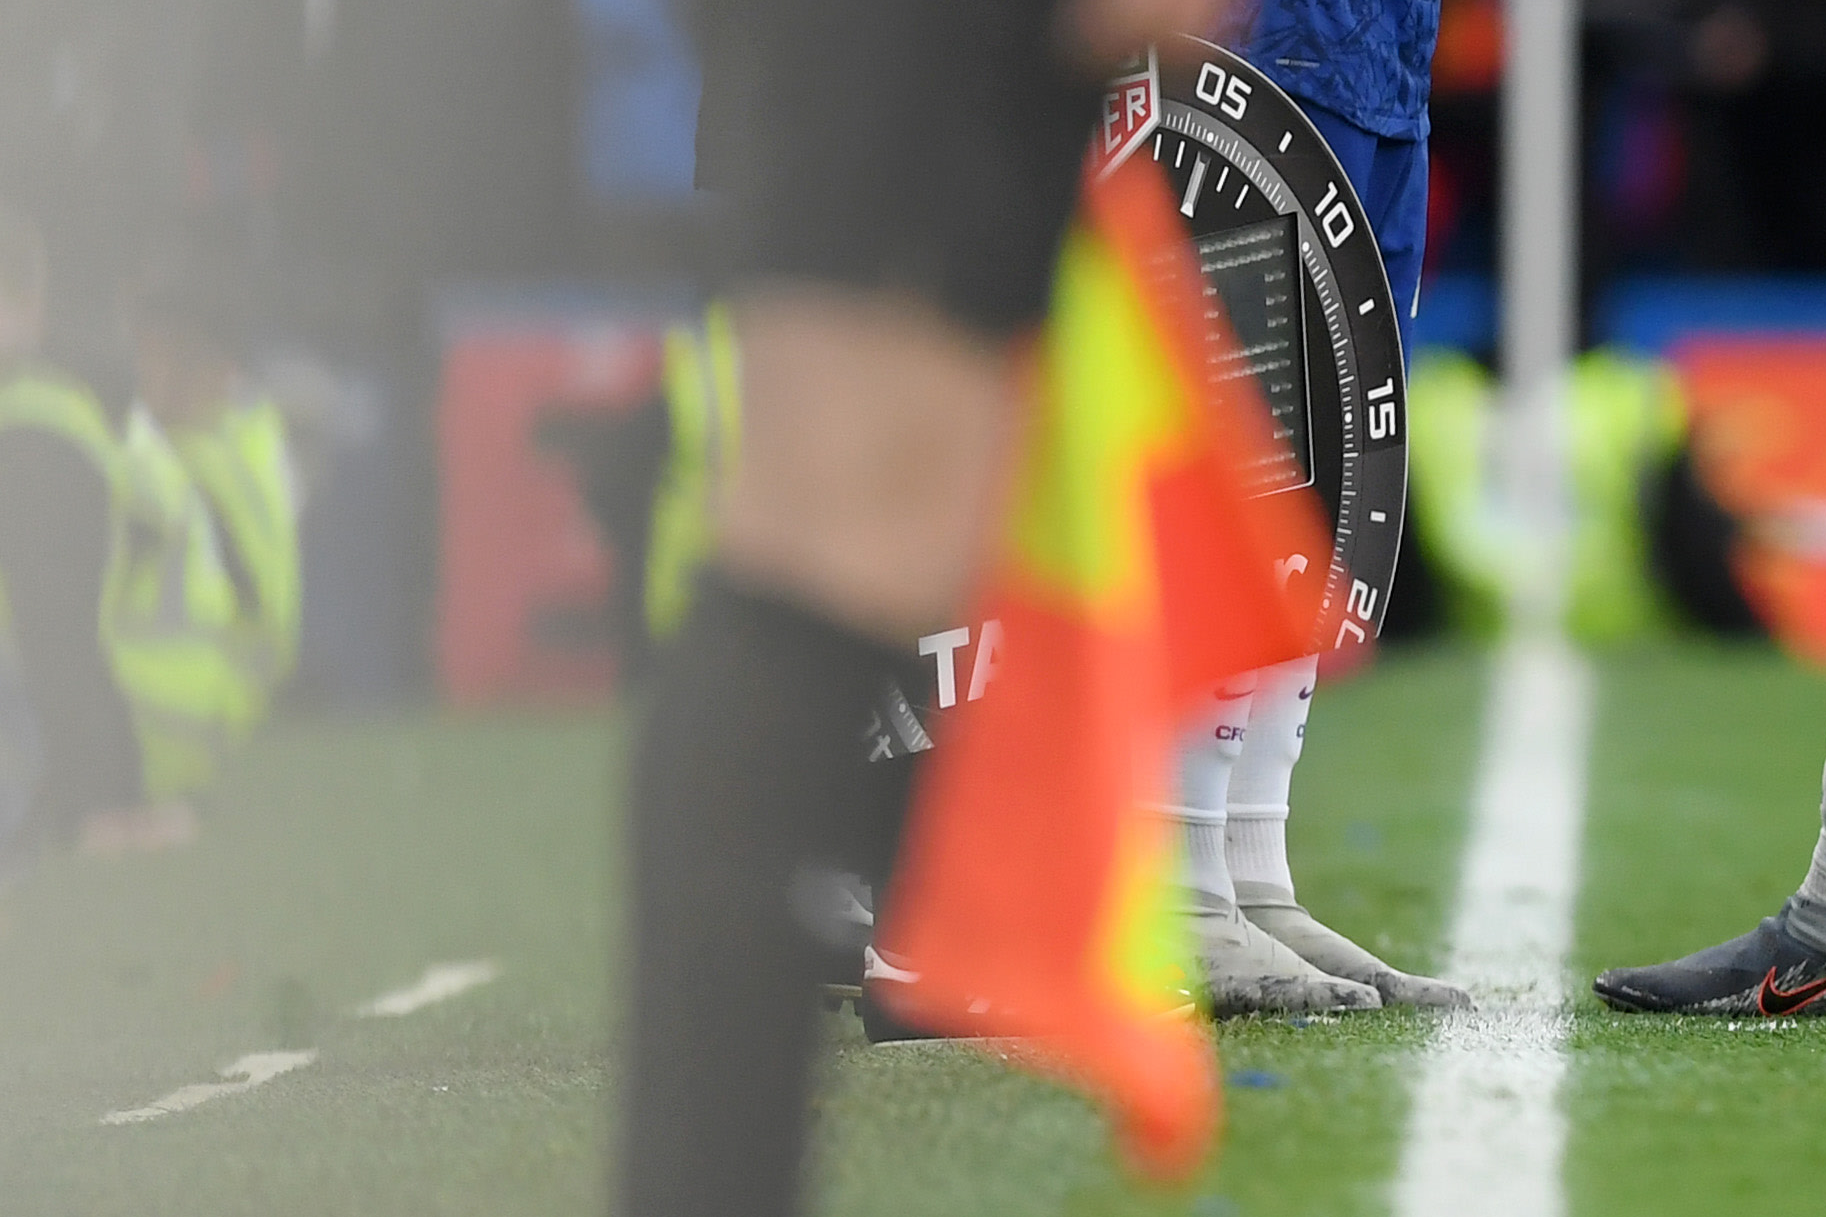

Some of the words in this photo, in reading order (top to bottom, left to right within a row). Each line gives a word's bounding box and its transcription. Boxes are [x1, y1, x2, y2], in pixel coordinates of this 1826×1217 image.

[1196, 62, 1252, 120] 05
[1314, 181, 1354, 248] 10
[1367, 377, 1395, 440] 15
